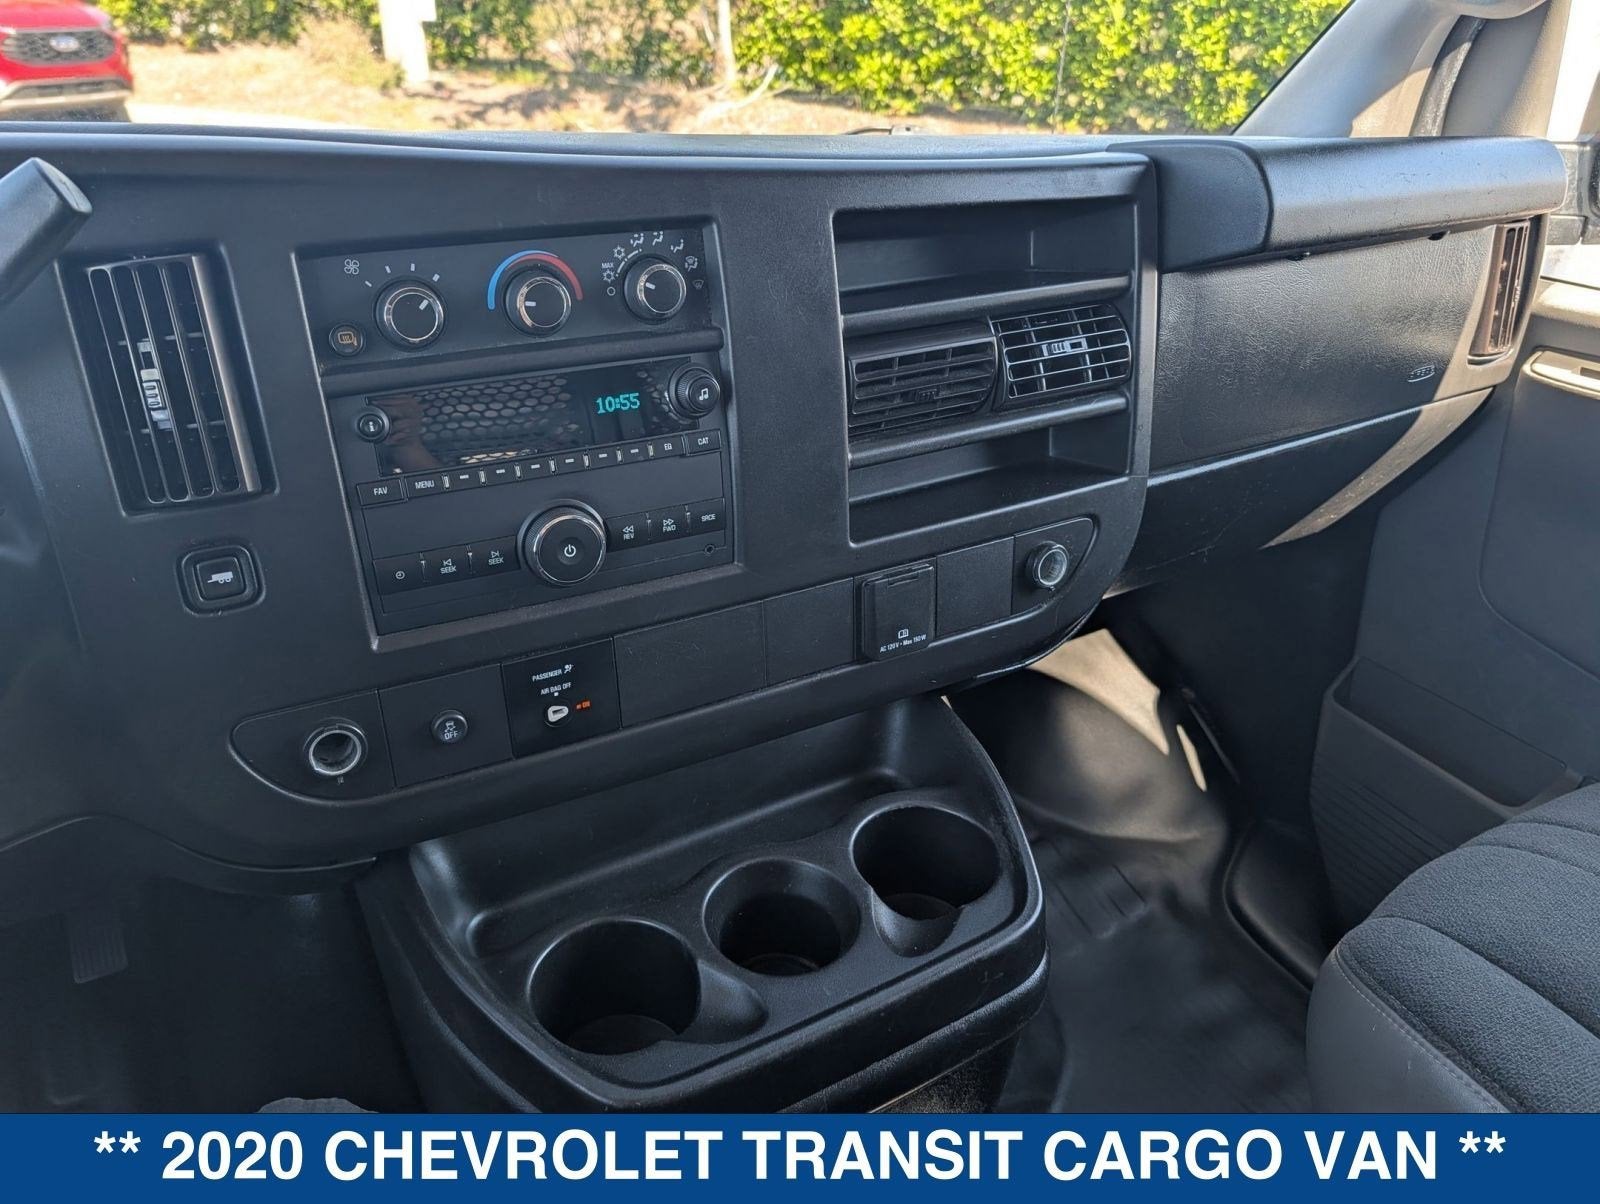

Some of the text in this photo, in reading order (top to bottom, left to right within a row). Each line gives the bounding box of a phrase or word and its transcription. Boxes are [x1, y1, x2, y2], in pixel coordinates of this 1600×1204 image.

[596, 392, 640, 414] 10:55
[697, 437, 709, 446] CAT
[414, 480, 435, 490] MENU
[373, 486, 388, 496] FAV
[701, 513, 716, 522] SRCE
[662, 525, 676, 533] FWD
[488, 557, 504, 566] SEEK
[440, 565, 457, 574] SEEK
[532, 669, 562, 682] PASSENGER
[562, 682, 571, 690] OFF
[444, 730, 459, 740] OFF
